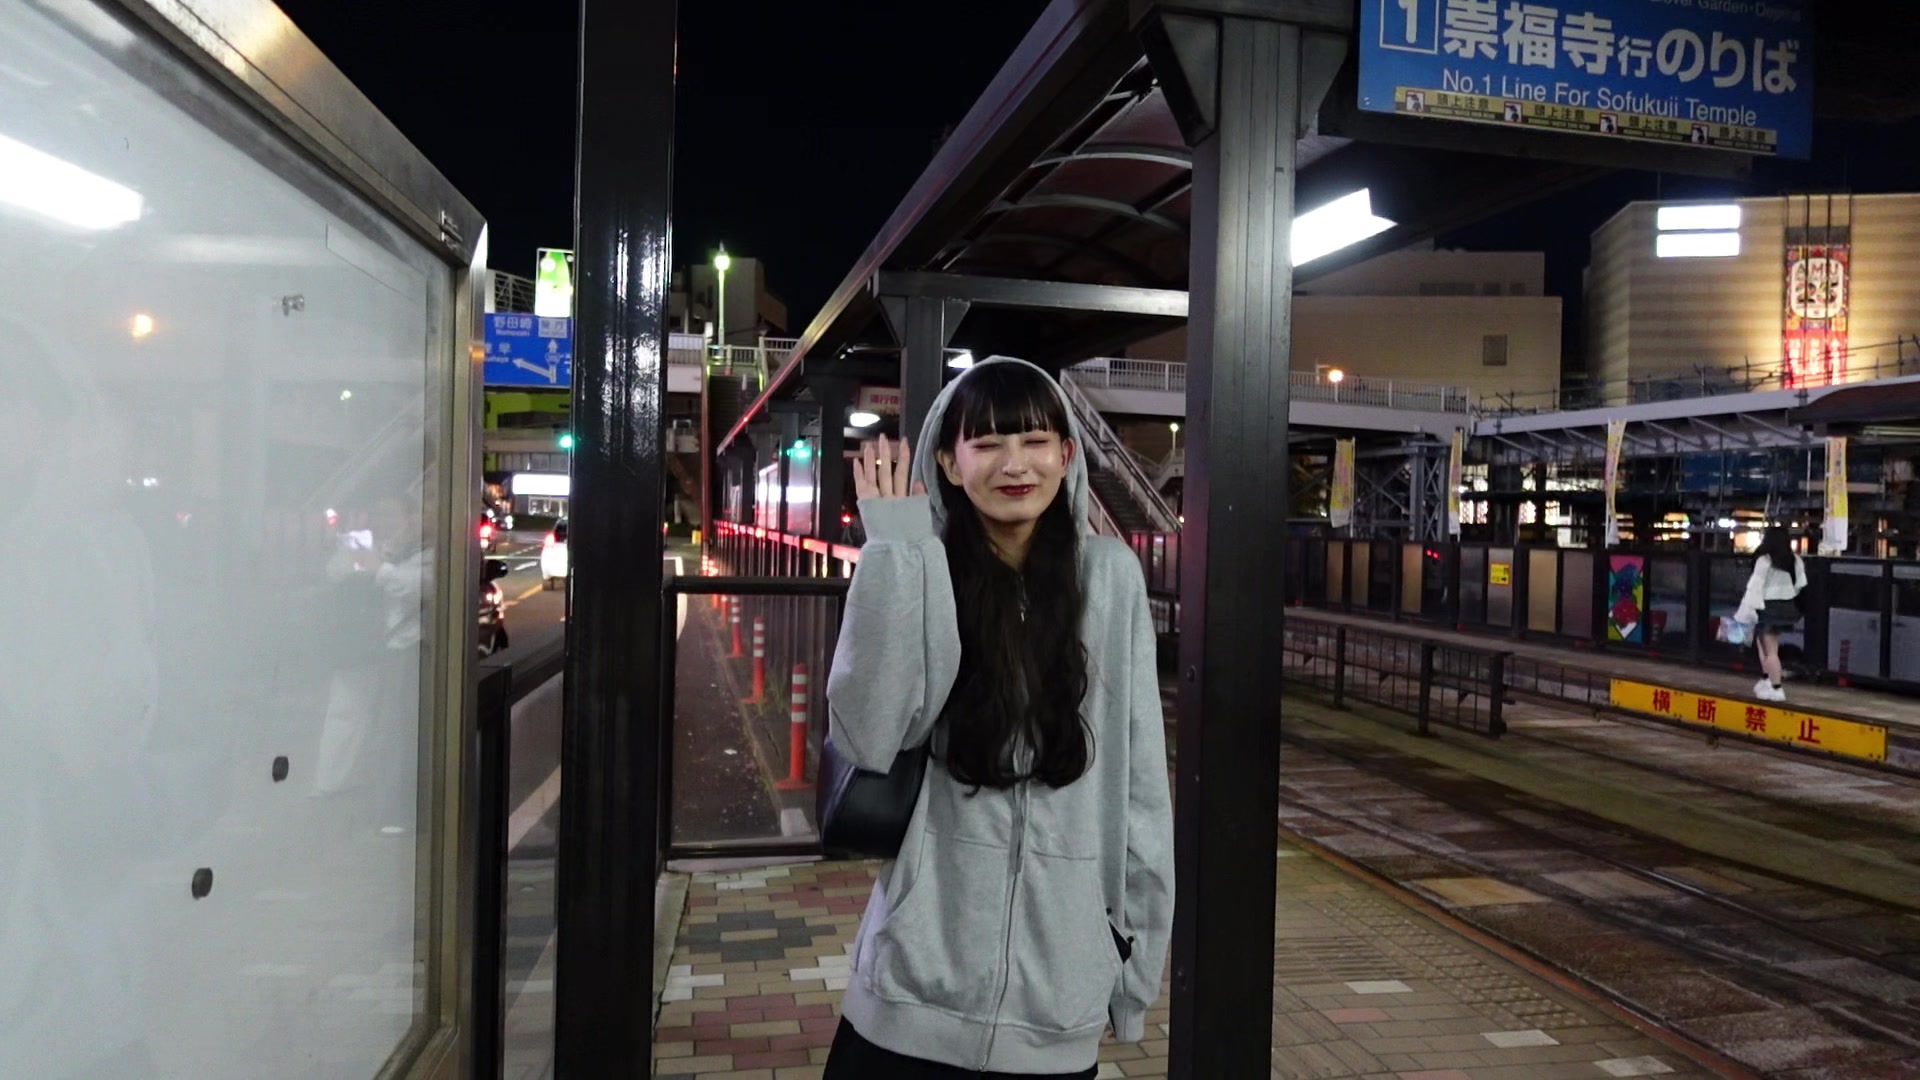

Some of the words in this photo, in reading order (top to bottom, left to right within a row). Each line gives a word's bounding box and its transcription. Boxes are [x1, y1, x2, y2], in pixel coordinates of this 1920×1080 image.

[1398, 0, 1418, 44] 1
[1442, 68, 1491, 96] No.1
[1502, 75, 1547, 102] Line
[1555, 82, 1590, 107] For
[1597, 87, 1679, 118] Sofukuji
[1685, 98, 1758, 127] Temple
[1652, 688, 1821, 744] 横断禁止
